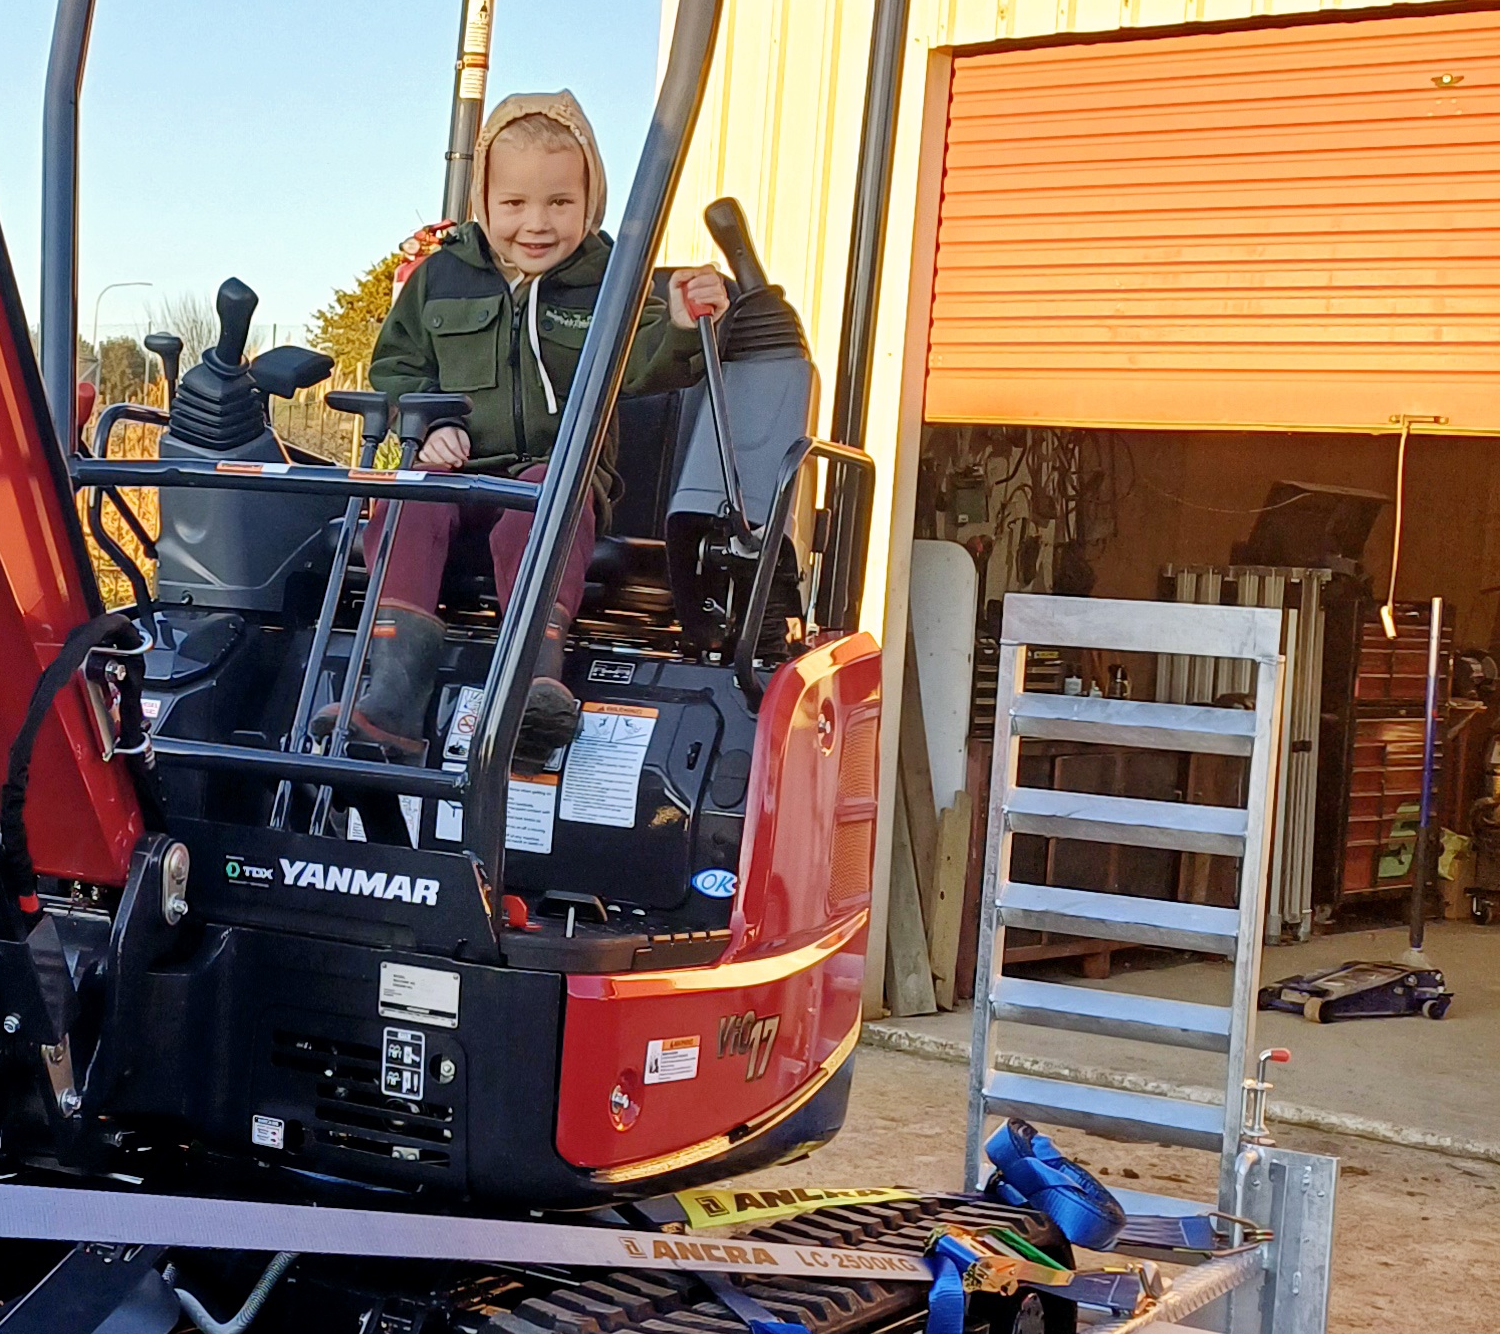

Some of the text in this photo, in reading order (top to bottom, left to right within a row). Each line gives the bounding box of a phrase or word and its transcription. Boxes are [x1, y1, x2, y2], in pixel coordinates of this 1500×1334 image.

[278, 856, 441, 907] YANMAR
[701, 873, 735, 894] OK
[653, 1239, 921, 1273] ANCRA LC 2500KG
